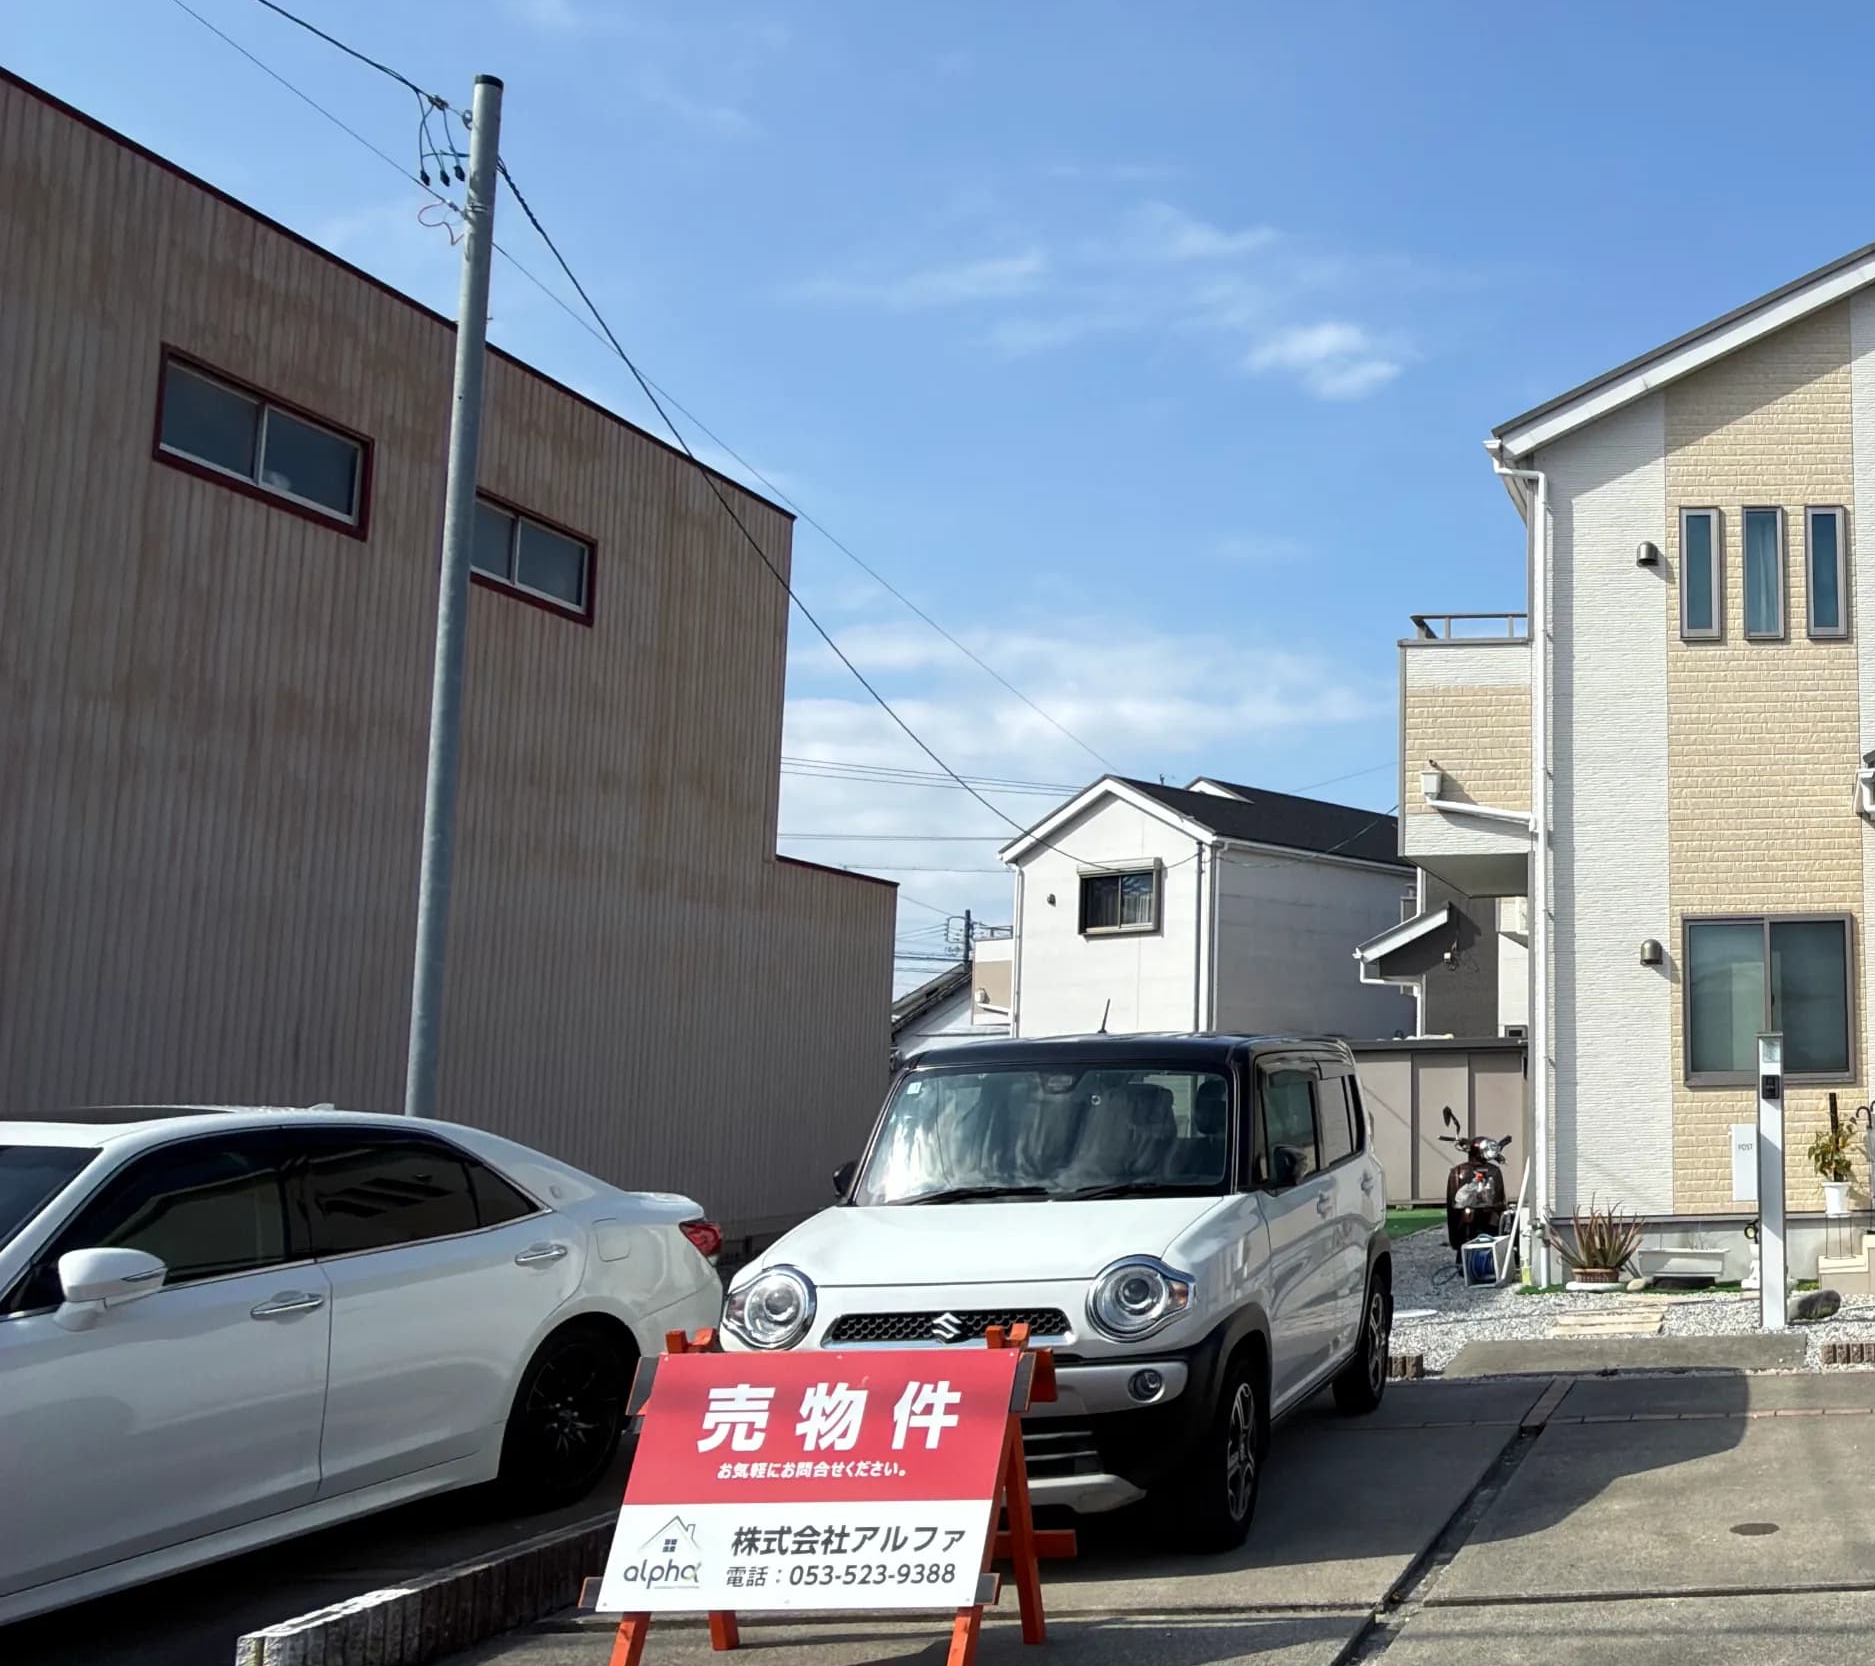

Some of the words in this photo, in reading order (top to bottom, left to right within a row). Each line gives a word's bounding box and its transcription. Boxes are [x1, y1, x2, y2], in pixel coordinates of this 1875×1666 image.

[717, 1461, 906, 1479] お気軽にお問合せください。
[731, 1525, 966, 1556] 株式会社アルファ
[623, 1558, 702, 1590] alpha
